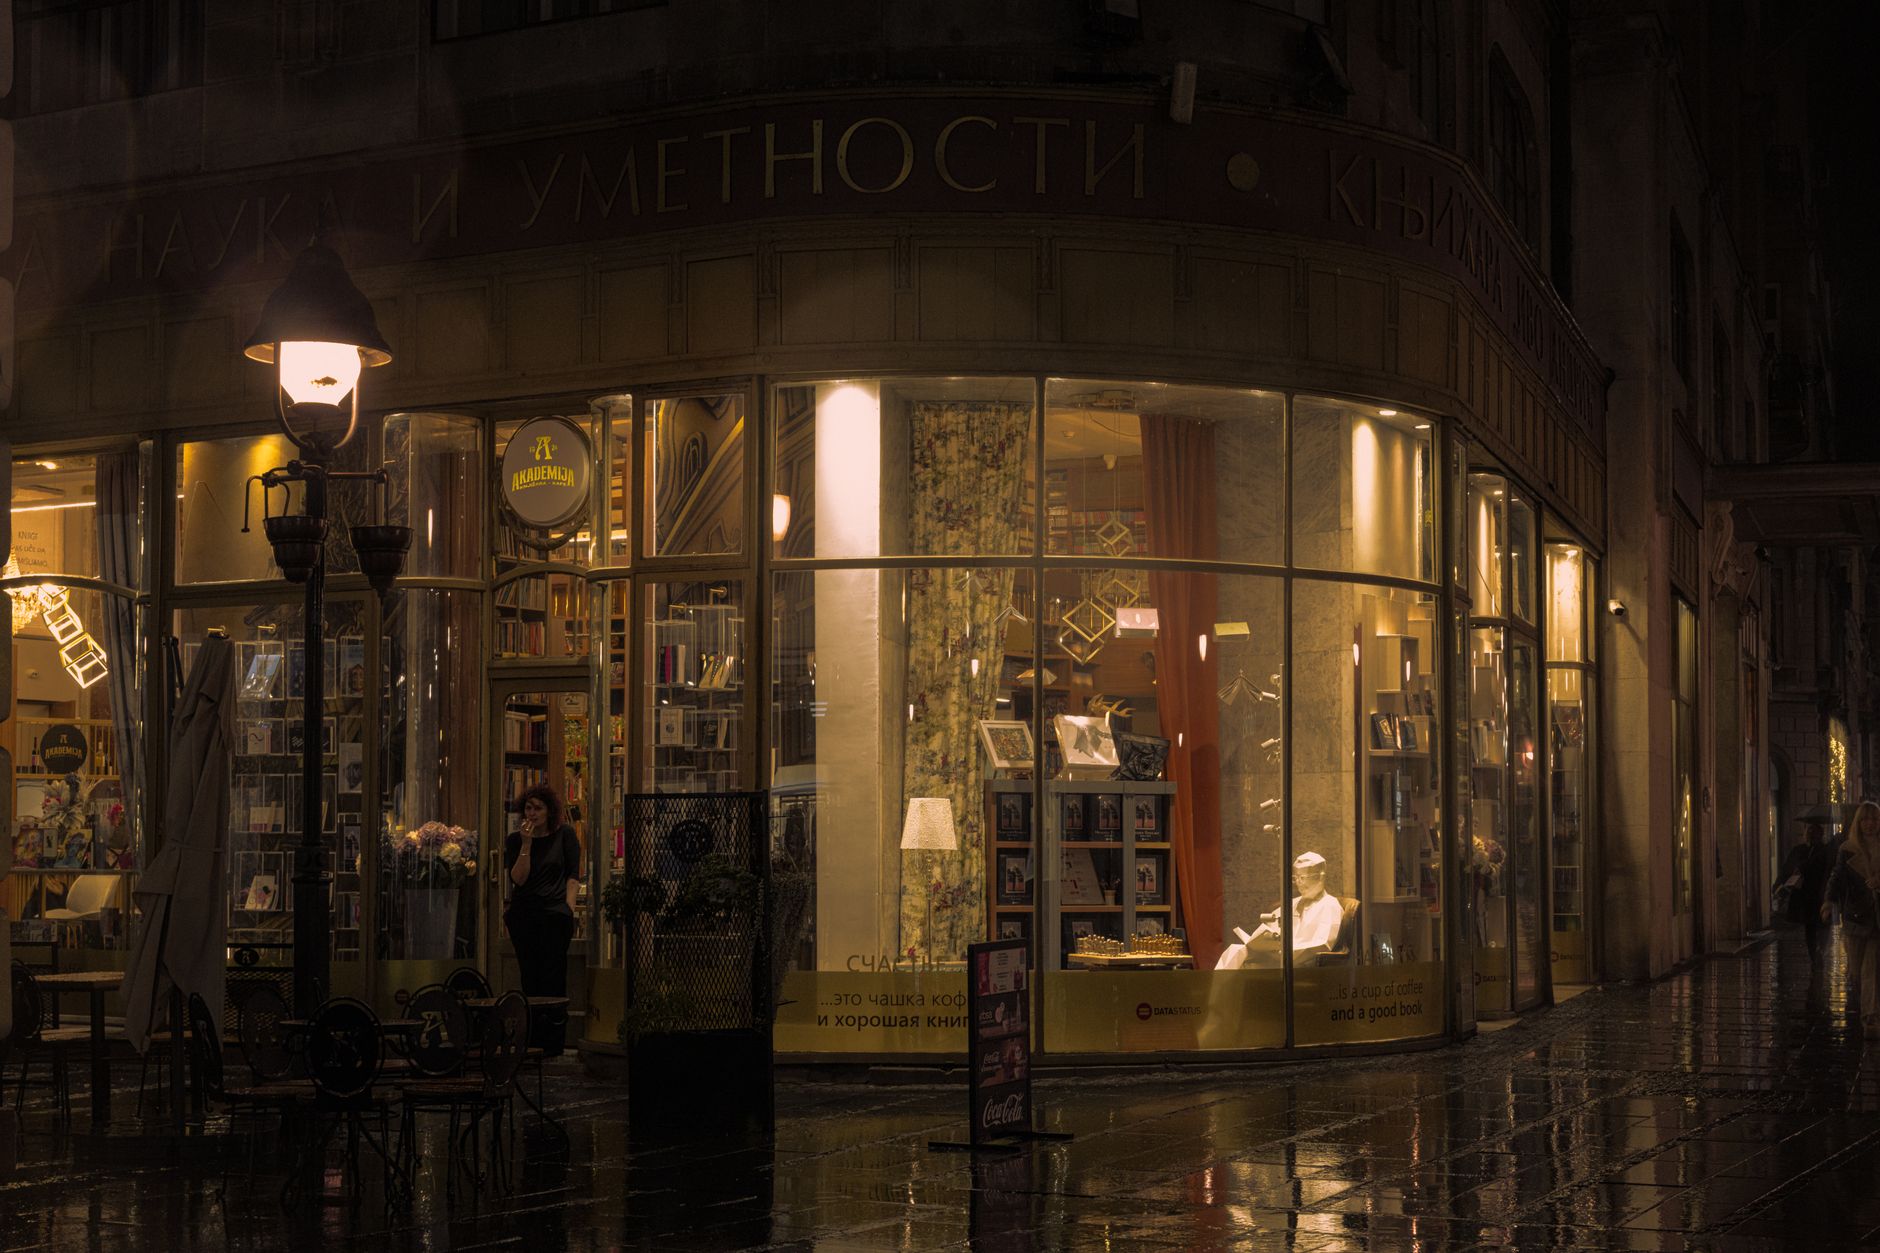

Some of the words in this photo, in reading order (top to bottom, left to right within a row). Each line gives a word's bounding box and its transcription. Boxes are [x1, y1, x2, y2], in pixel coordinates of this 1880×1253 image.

[412, 170, 459, 243] И
[517, 115, 1146, 230] УМЕТНОСТИ
[511, 465, 576, 492] AKADEMIJA
[868, 993, 925, 1007] чашка
[1351, 989, 1358, 998] a
[1361, 985, 1382, 1001] cup
[1384, 980, 1395, 996] of
[1396, 978, 1424, 996] coffee
[817, 1015, 828, 1027] и
[834, 1014, 920, 1031] хорошая
[1153, 1006, 1202, 1016] DATASTATUS
[1330, 1004, 1355, 1022] and
[1358, 1007, 1365, 1019] a
[1368, 1002, 1397, 1024] good
[1399, 1001, 1423, 1017] book
[982, 1093, 1025, 1129] Coca-Cola
